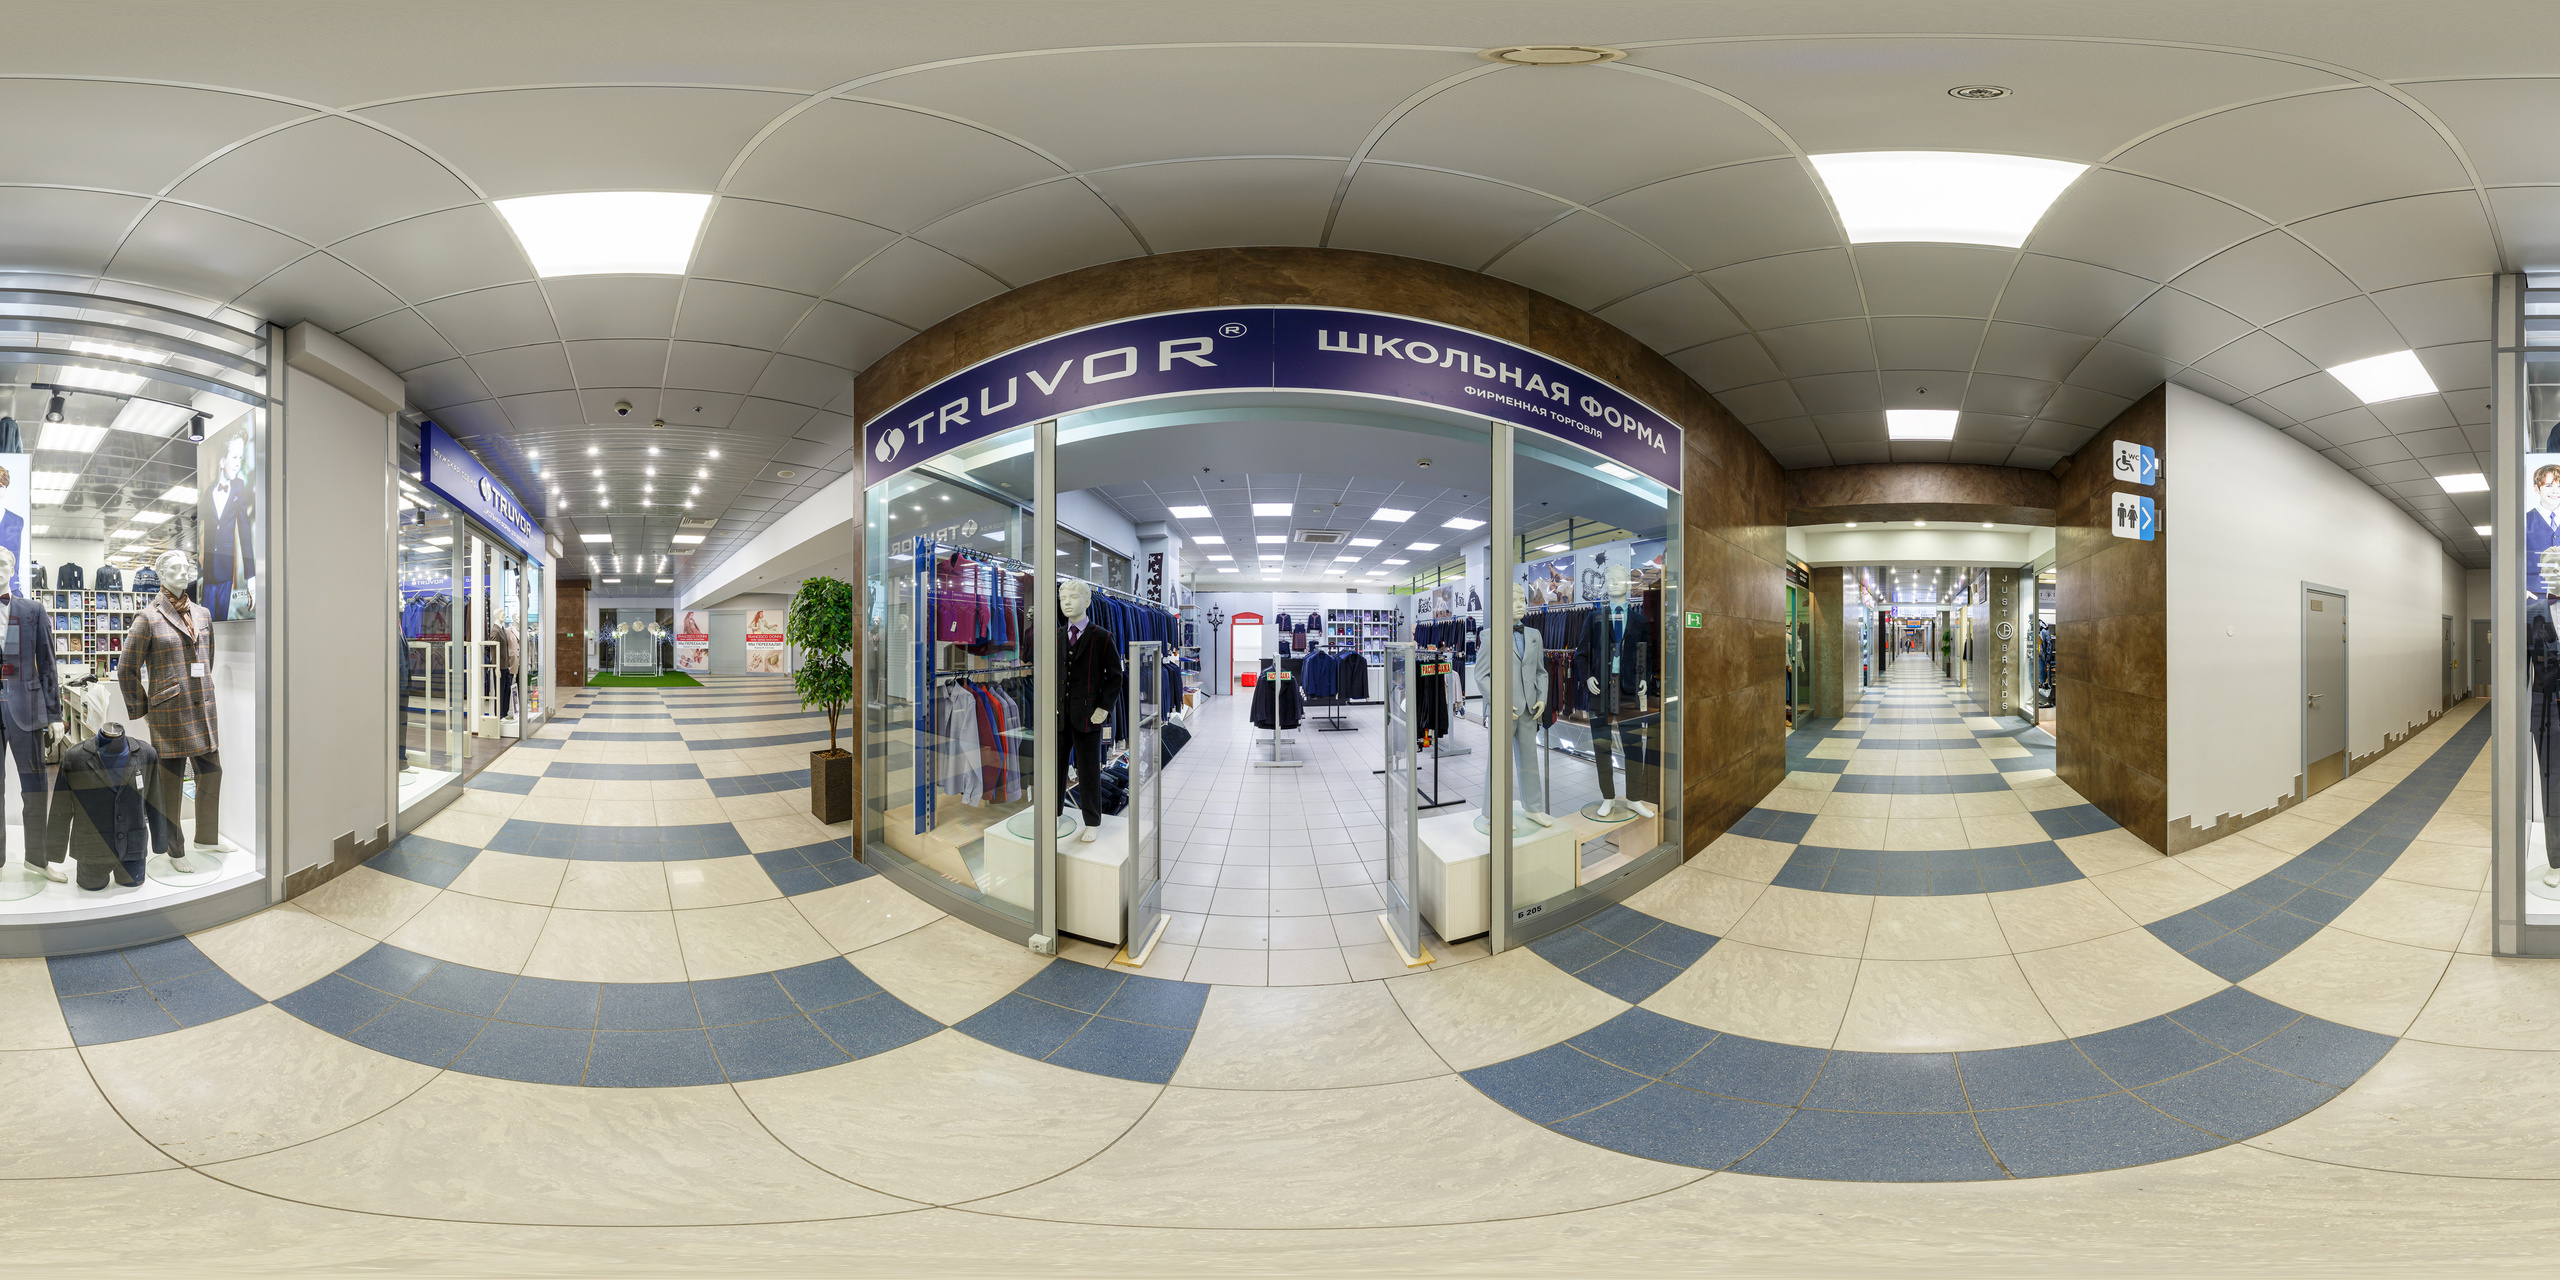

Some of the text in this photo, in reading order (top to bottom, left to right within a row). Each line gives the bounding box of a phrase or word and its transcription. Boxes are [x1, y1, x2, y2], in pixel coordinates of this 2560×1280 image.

[908, 336, 1218, 445] TRUVOR
[1318, 328, 1667, 455] ШКОЛЬНАЯ ФОРМА
[1464, 385, 1603, 440] ФИРМЕННАЯ ТОРГОВЛЯ
[2128, 453, 2140, 461] WC
[491, 486, 532, 538] TRUVOR
[1518, 905, 1542, 919] Б 205
